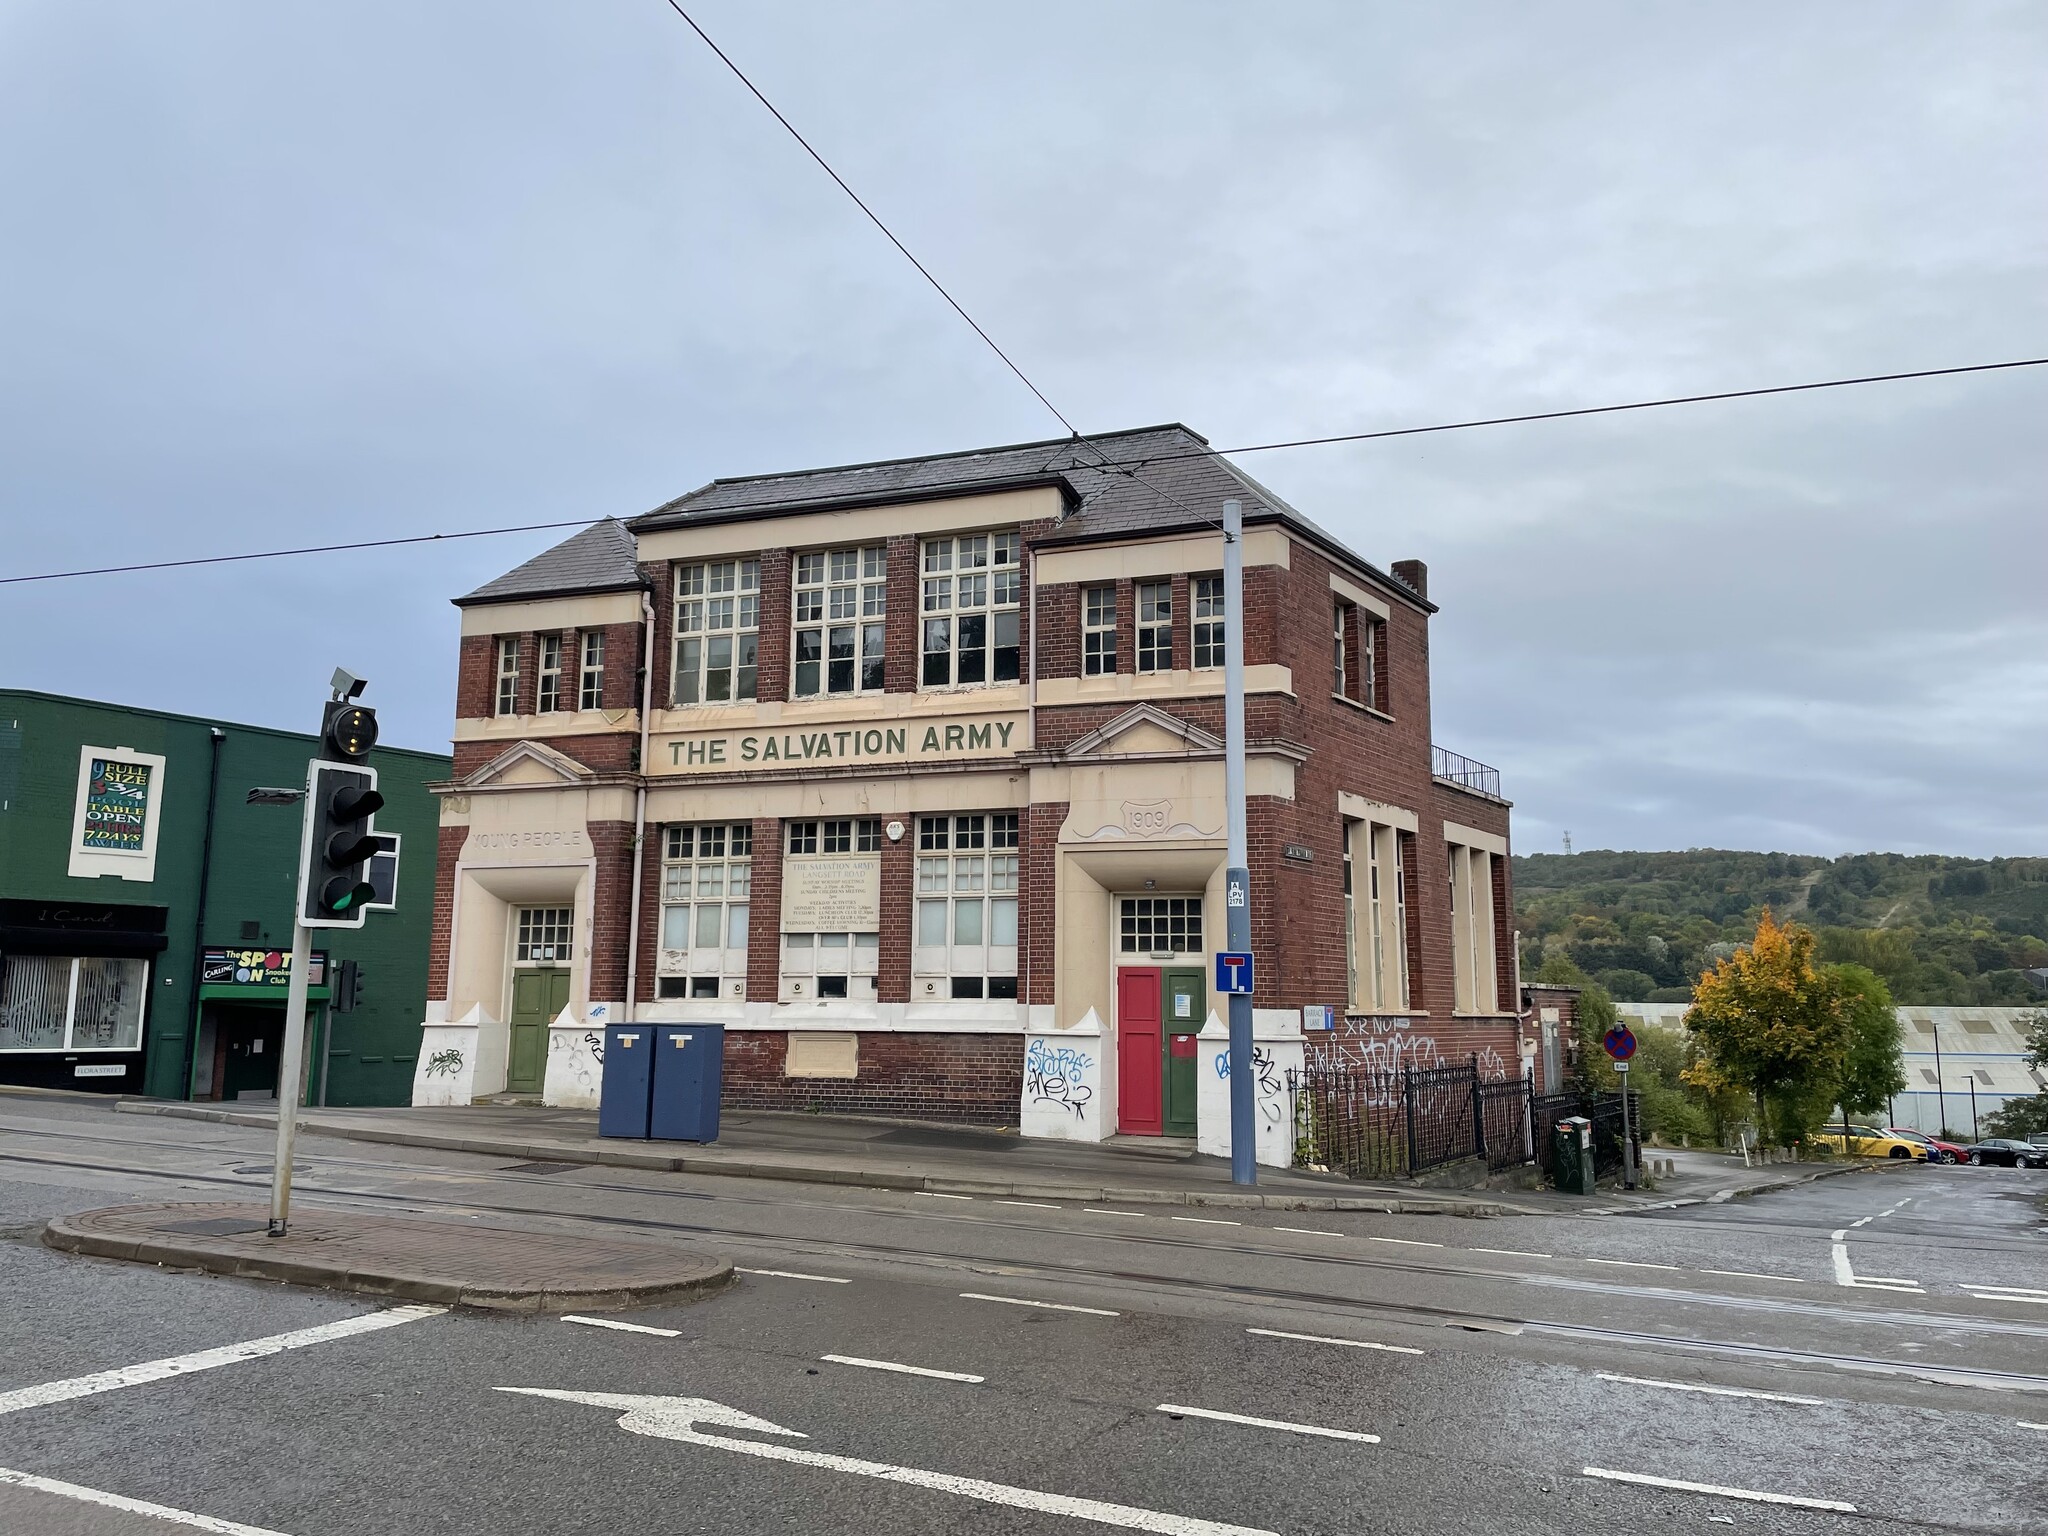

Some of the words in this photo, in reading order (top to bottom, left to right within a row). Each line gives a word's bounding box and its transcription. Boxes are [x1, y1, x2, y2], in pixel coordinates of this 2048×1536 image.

[668, 739, 727, 766] THE
[740, 728, 906, 762] SALVATION
[921, 721, 1015, 753] ARMY
[92, 761, 105, 780] 9
[106, 763, 147, 776] FULL
[105, 772, 146, 785] SIZE
[90, 796, 144, 807] POOL
[89, 803, 145, 815] TABLE
[87, 811, 142, 824] OPEN
[1130, 811, 1164, 828] 1909
[107, 823, 141, 834] HRS
[97, 832, 141, 841] DAYS
[473, 833, 518, 848] YOUNG
[523, 831, 581, 847] PEOPLE
[810, 863, 850, 871] SALVATION
[853, 862, 875, 870] ARMY
[225, 950, 241, 959] The
[238, 951, 293, 969] SPOT
[204, 964, 233, 979] CARLING
[236, 968, 264, 982] ON
[1305, 1009, 1323, 1017] BARRACK
[1310, 1019, 1320, 1027] LANE
